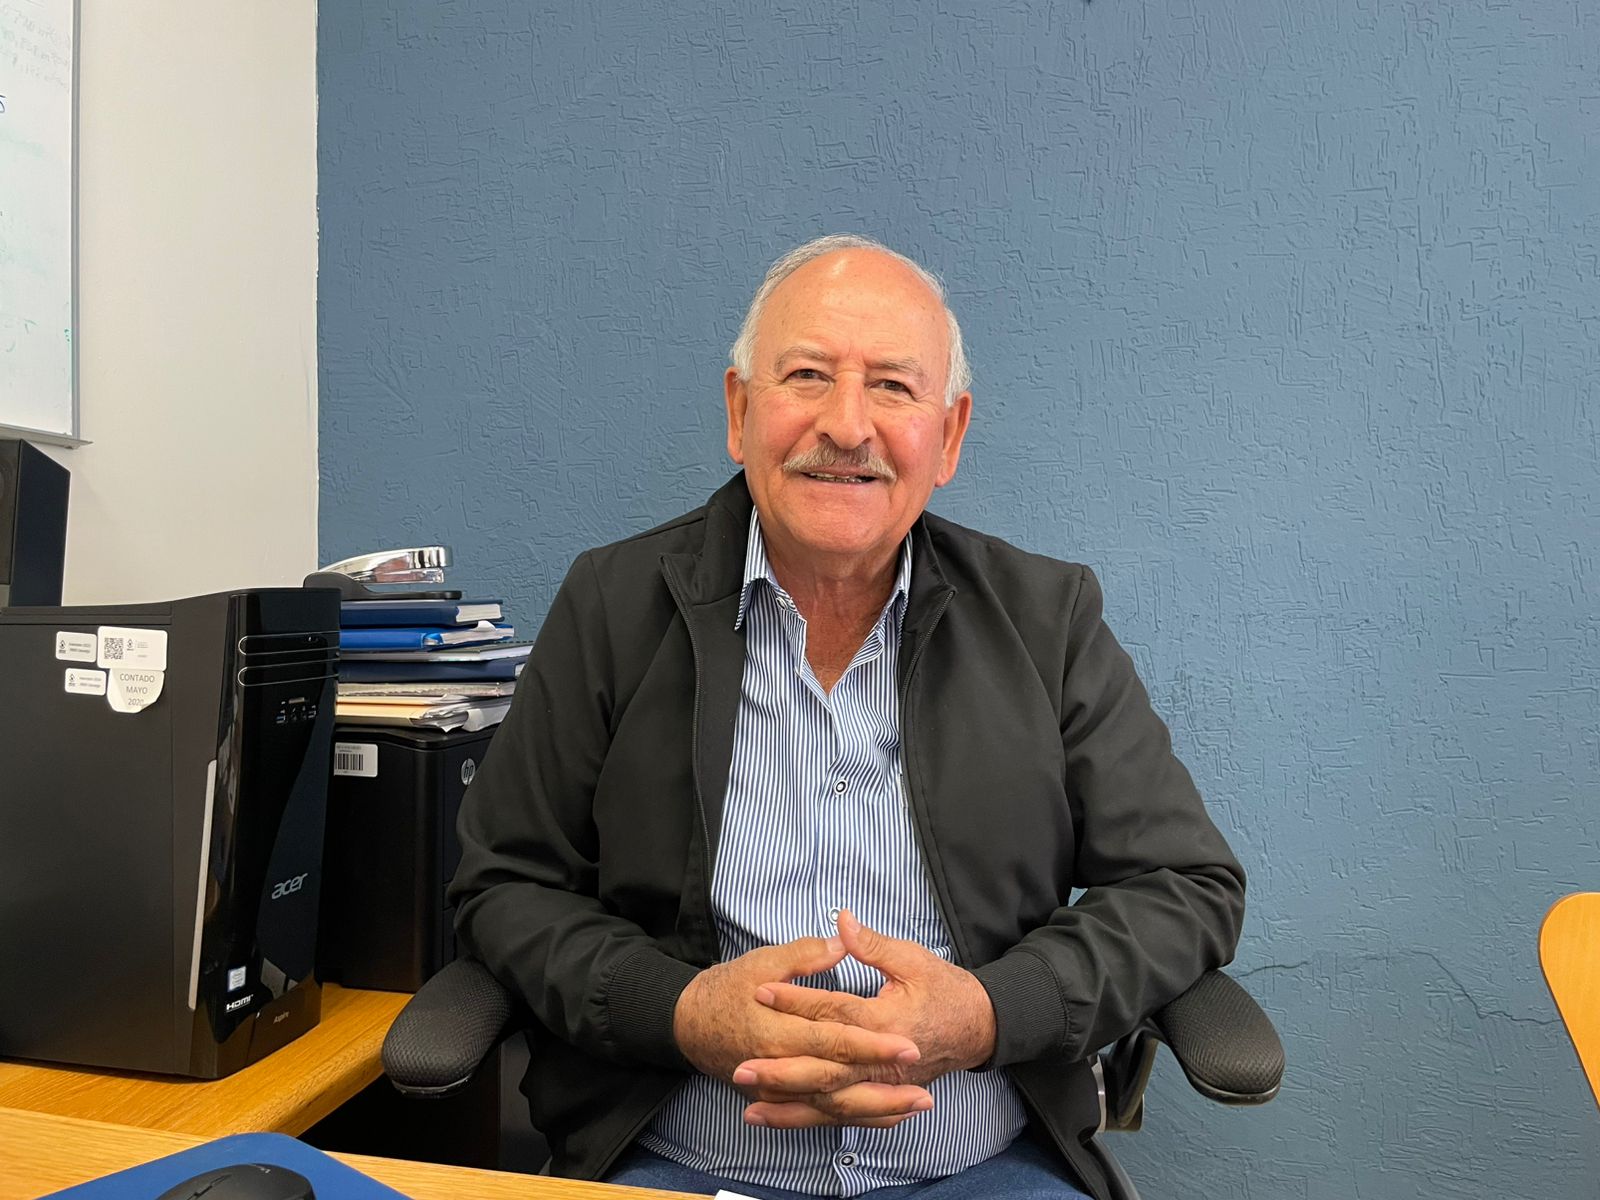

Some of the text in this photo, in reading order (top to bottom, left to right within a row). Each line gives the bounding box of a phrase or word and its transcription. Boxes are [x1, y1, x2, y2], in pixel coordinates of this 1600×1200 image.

[119, 673, 155, 683] CONTADO
[126, 685, 149, 694] MAYO
[271, 872, 309, 900] acer
